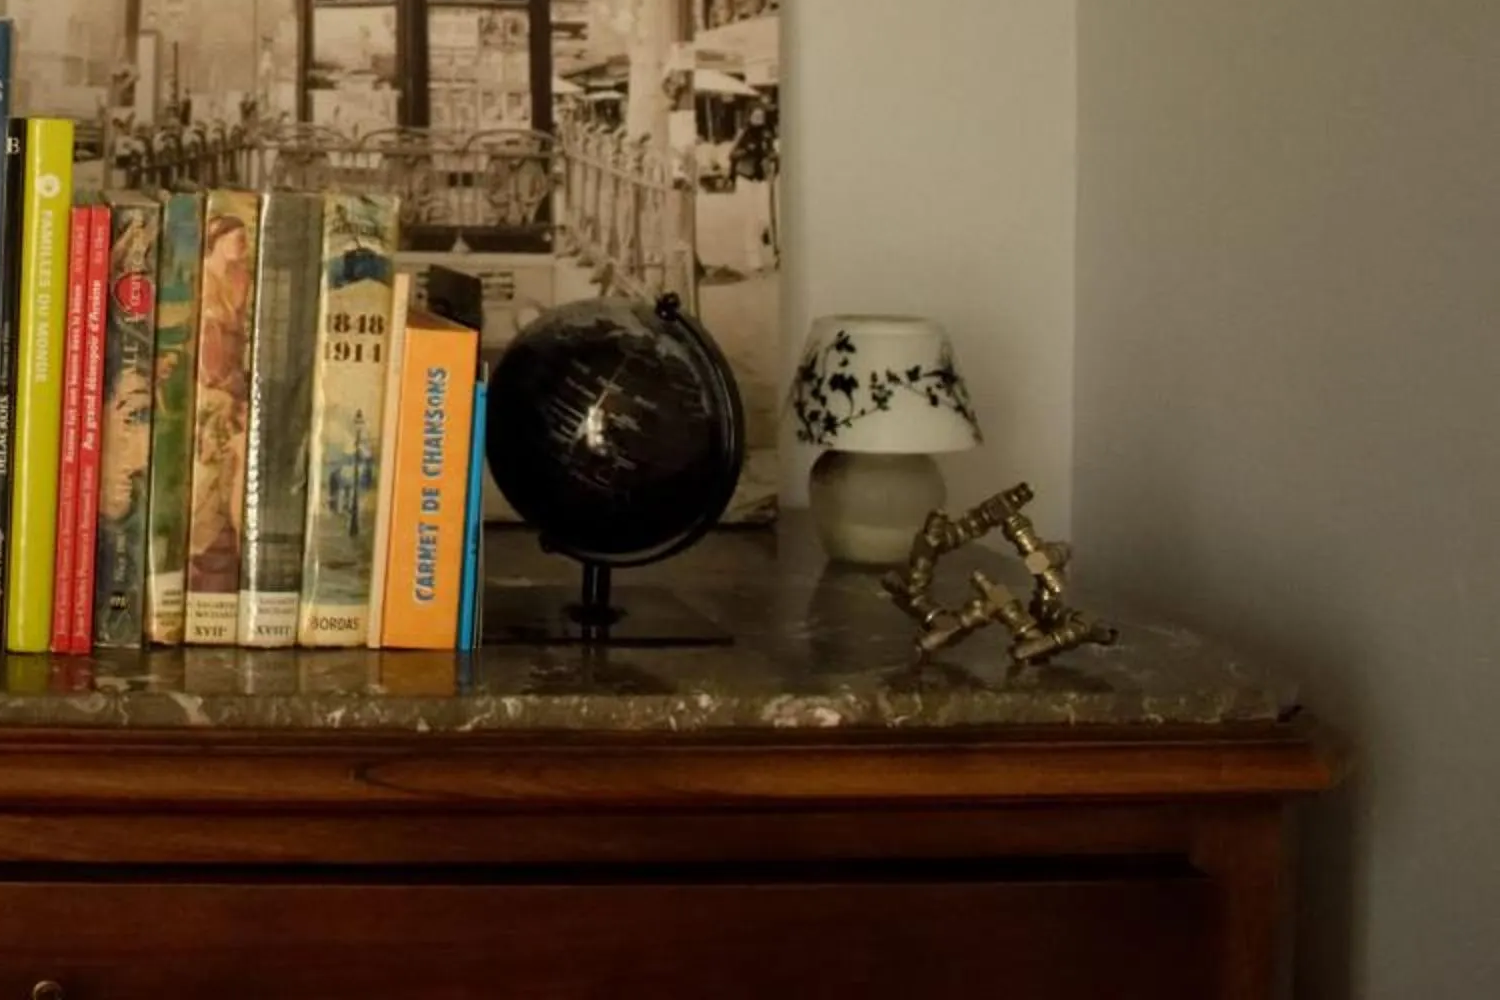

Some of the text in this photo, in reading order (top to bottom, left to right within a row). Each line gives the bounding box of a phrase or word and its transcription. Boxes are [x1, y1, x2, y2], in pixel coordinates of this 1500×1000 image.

[34, 209, 55, 385] FAMILLES DU MONDE
[83, 394, 98, 430] grand
[415, 367, 448, 602] CARNET DE CHANSONS
[308, 615, 360, 632] BORDAS
